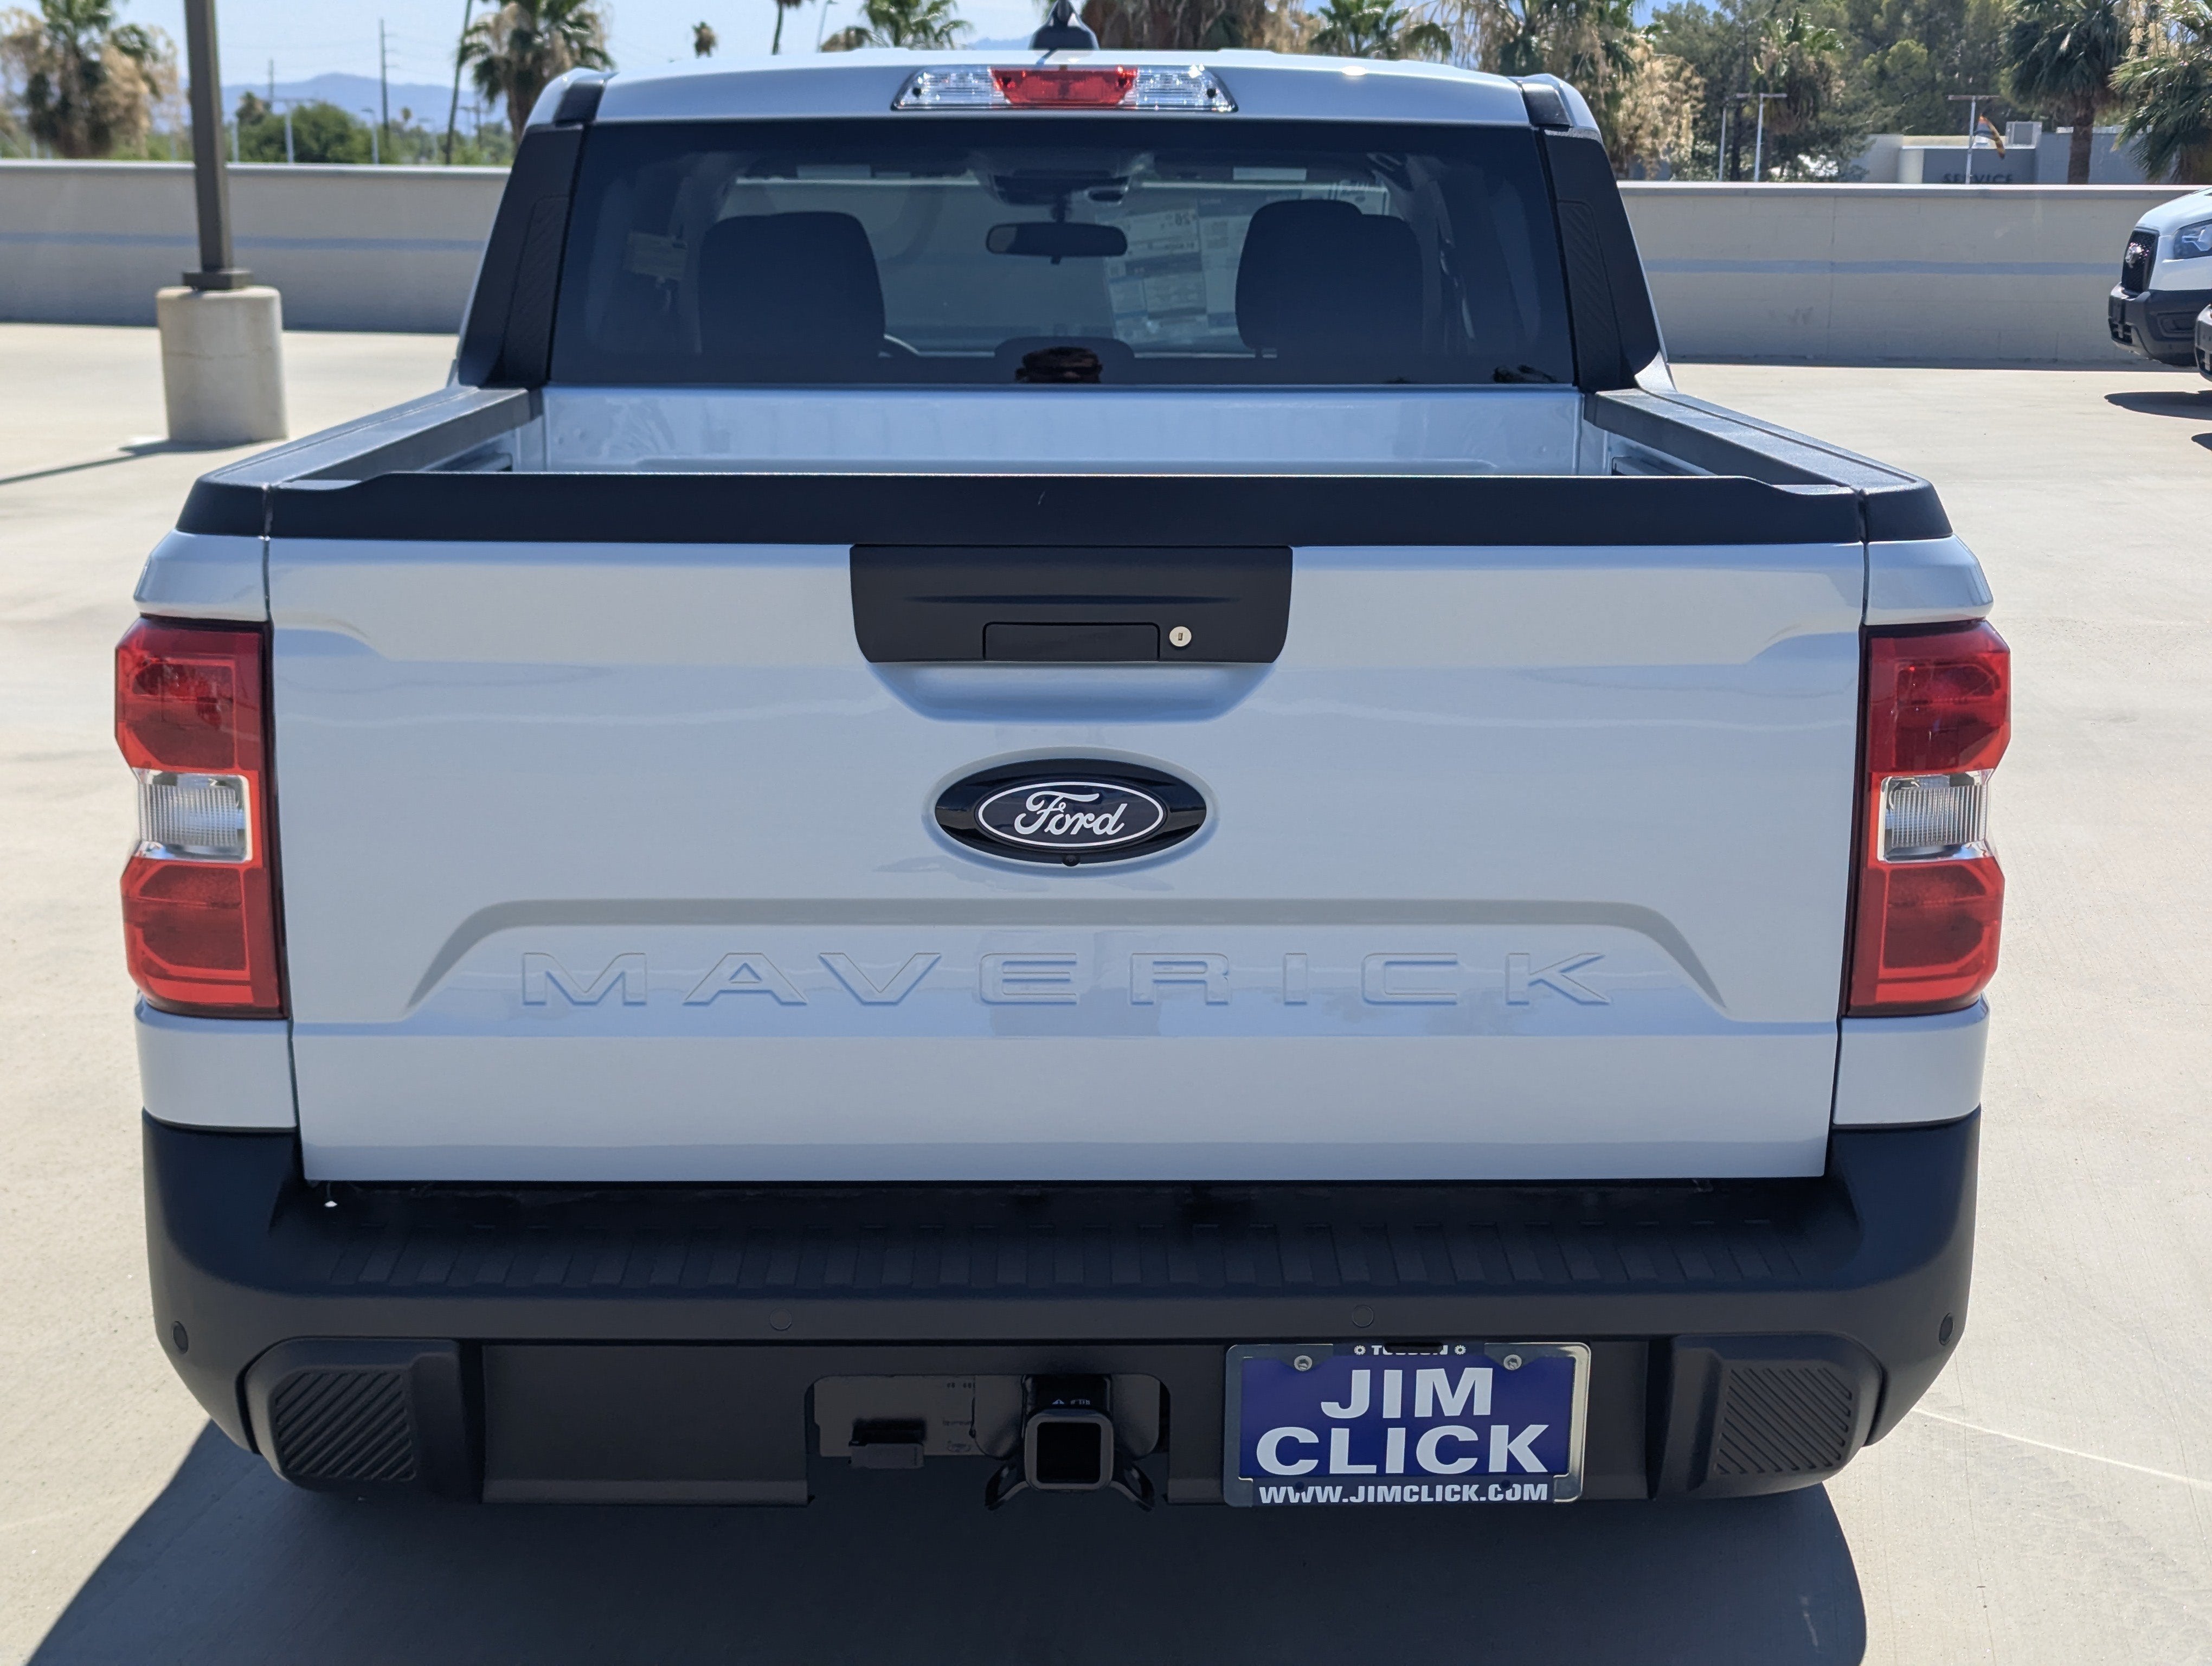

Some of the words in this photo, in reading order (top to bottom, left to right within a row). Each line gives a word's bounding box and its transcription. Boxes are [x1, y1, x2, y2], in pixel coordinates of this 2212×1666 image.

[1014, 790, 1128, 835] Ford
[522, 953, 1610, 1006] MAVERICK
[1321, 1367, 1493, 1419] JIM
[1256, 1424, 1549, 1475] CLICK
[1259, 1483, 1548, 1504] WWW.JIMCLICK.COM
